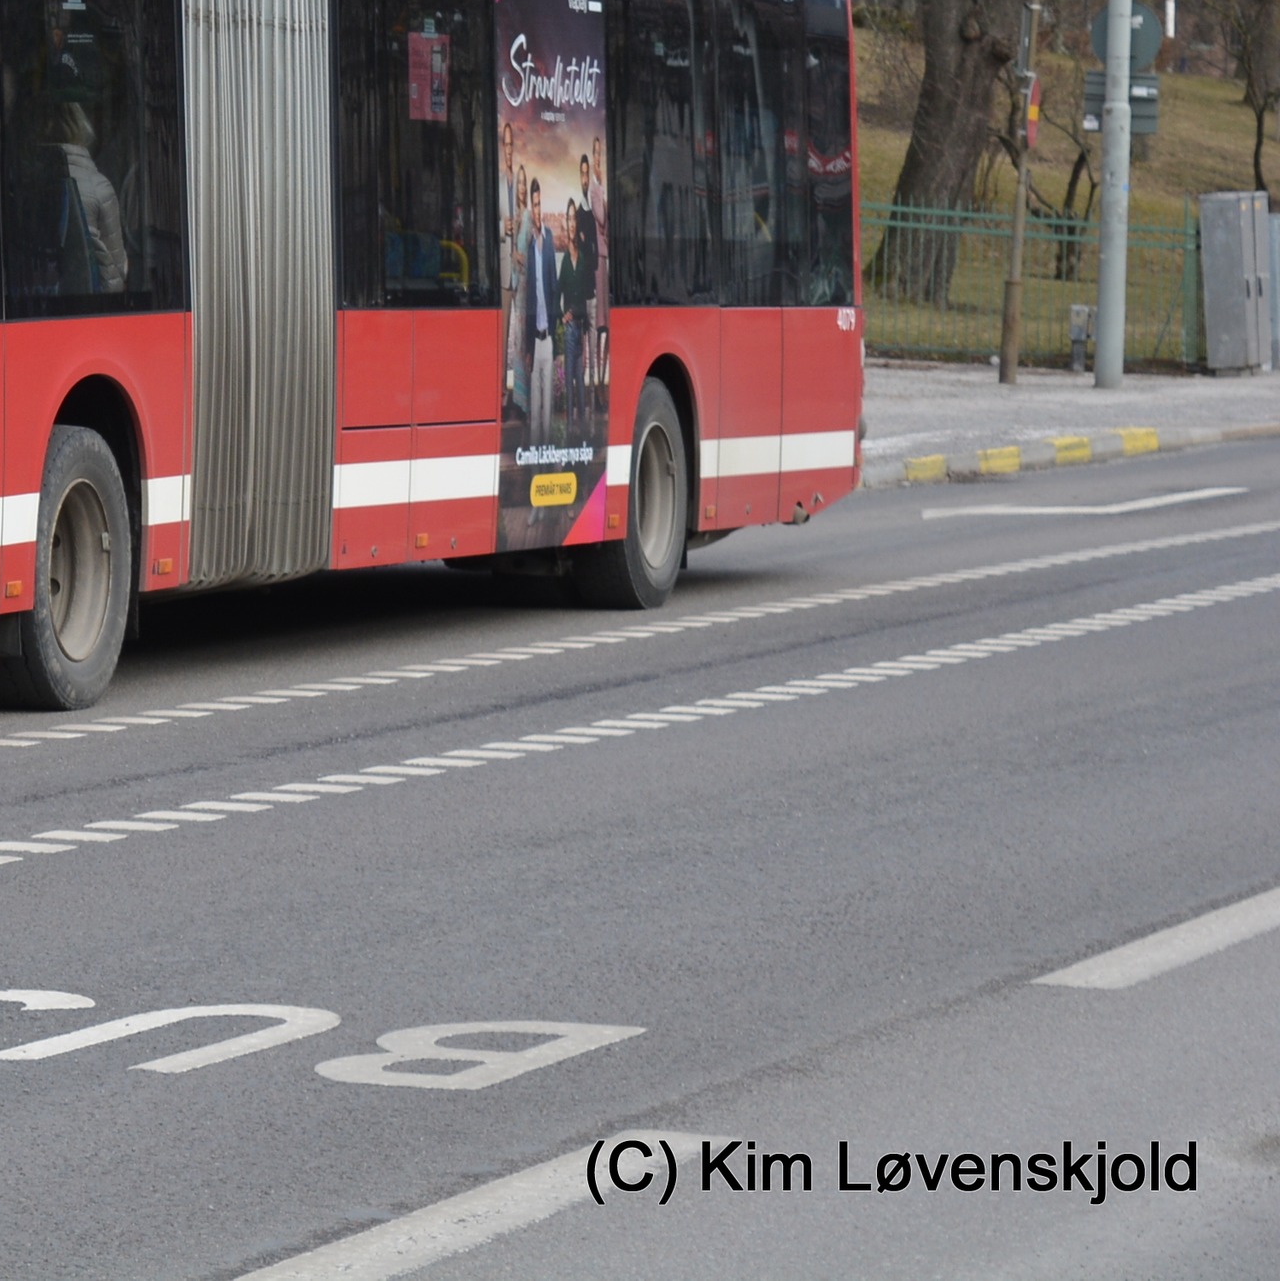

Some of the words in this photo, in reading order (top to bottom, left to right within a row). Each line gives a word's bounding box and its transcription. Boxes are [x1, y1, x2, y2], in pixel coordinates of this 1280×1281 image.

[502, 32, 602, 110] Strandhotellet
[515, 446, 539, 466] Camilla
[538, 444, 569, 466] Läckbergs
[568, 448, 579, 466] nya
[579, 440, 594, 466] såpa
[535, 481, 556, 498] PREMIÄR
[559, 482, 572, 495] MARS
